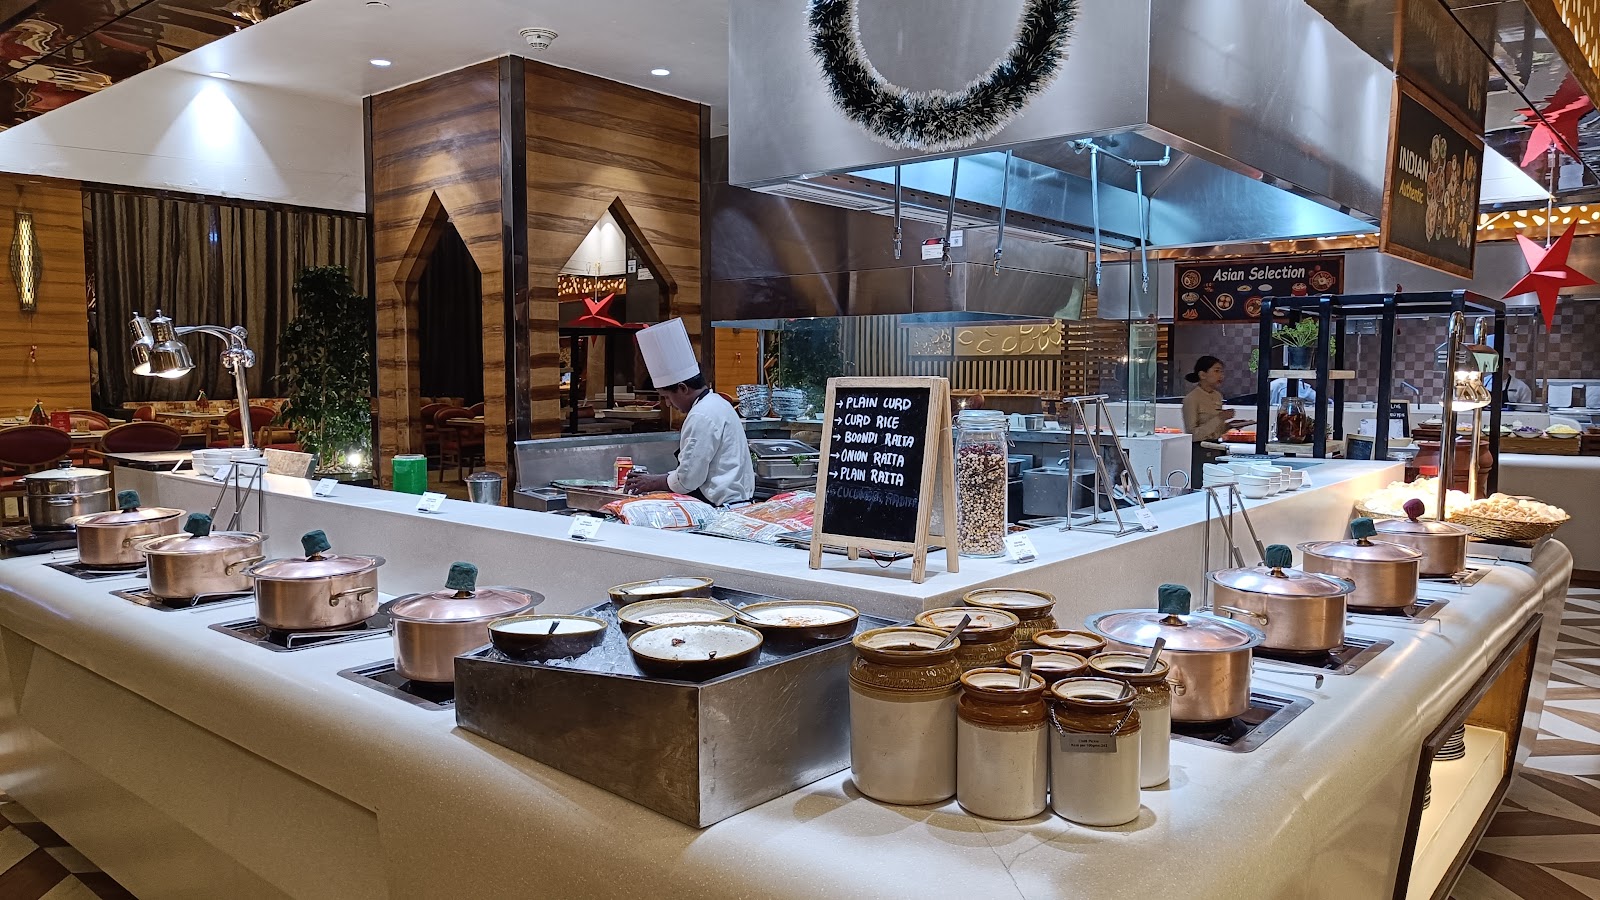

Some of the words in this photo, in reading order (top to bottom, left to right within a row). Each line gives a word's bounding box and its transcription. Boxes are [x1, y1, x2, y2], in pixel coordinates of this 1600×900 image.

[1399, 145, 1429, 183] INDIAN
[1212, 267, 1245, 282] Asian
[1249, 265, 1306, 281] Selection
[845, 396, 878, 409] PLAIN
[883, 397, 912, 411] CURD
[844, 413, 871, 428] CURD
[876, 415, 900, 430] RICE
[844, 431, 878, 444] BOONDI
[884, 433, 915, 448] RAITA
[840, 448, 869, 463] ONION
[873, 452, 905, 467] RAITA
[840, 466, 866, 481] PLAIN
[870, 469, 904, 487] RAITA
